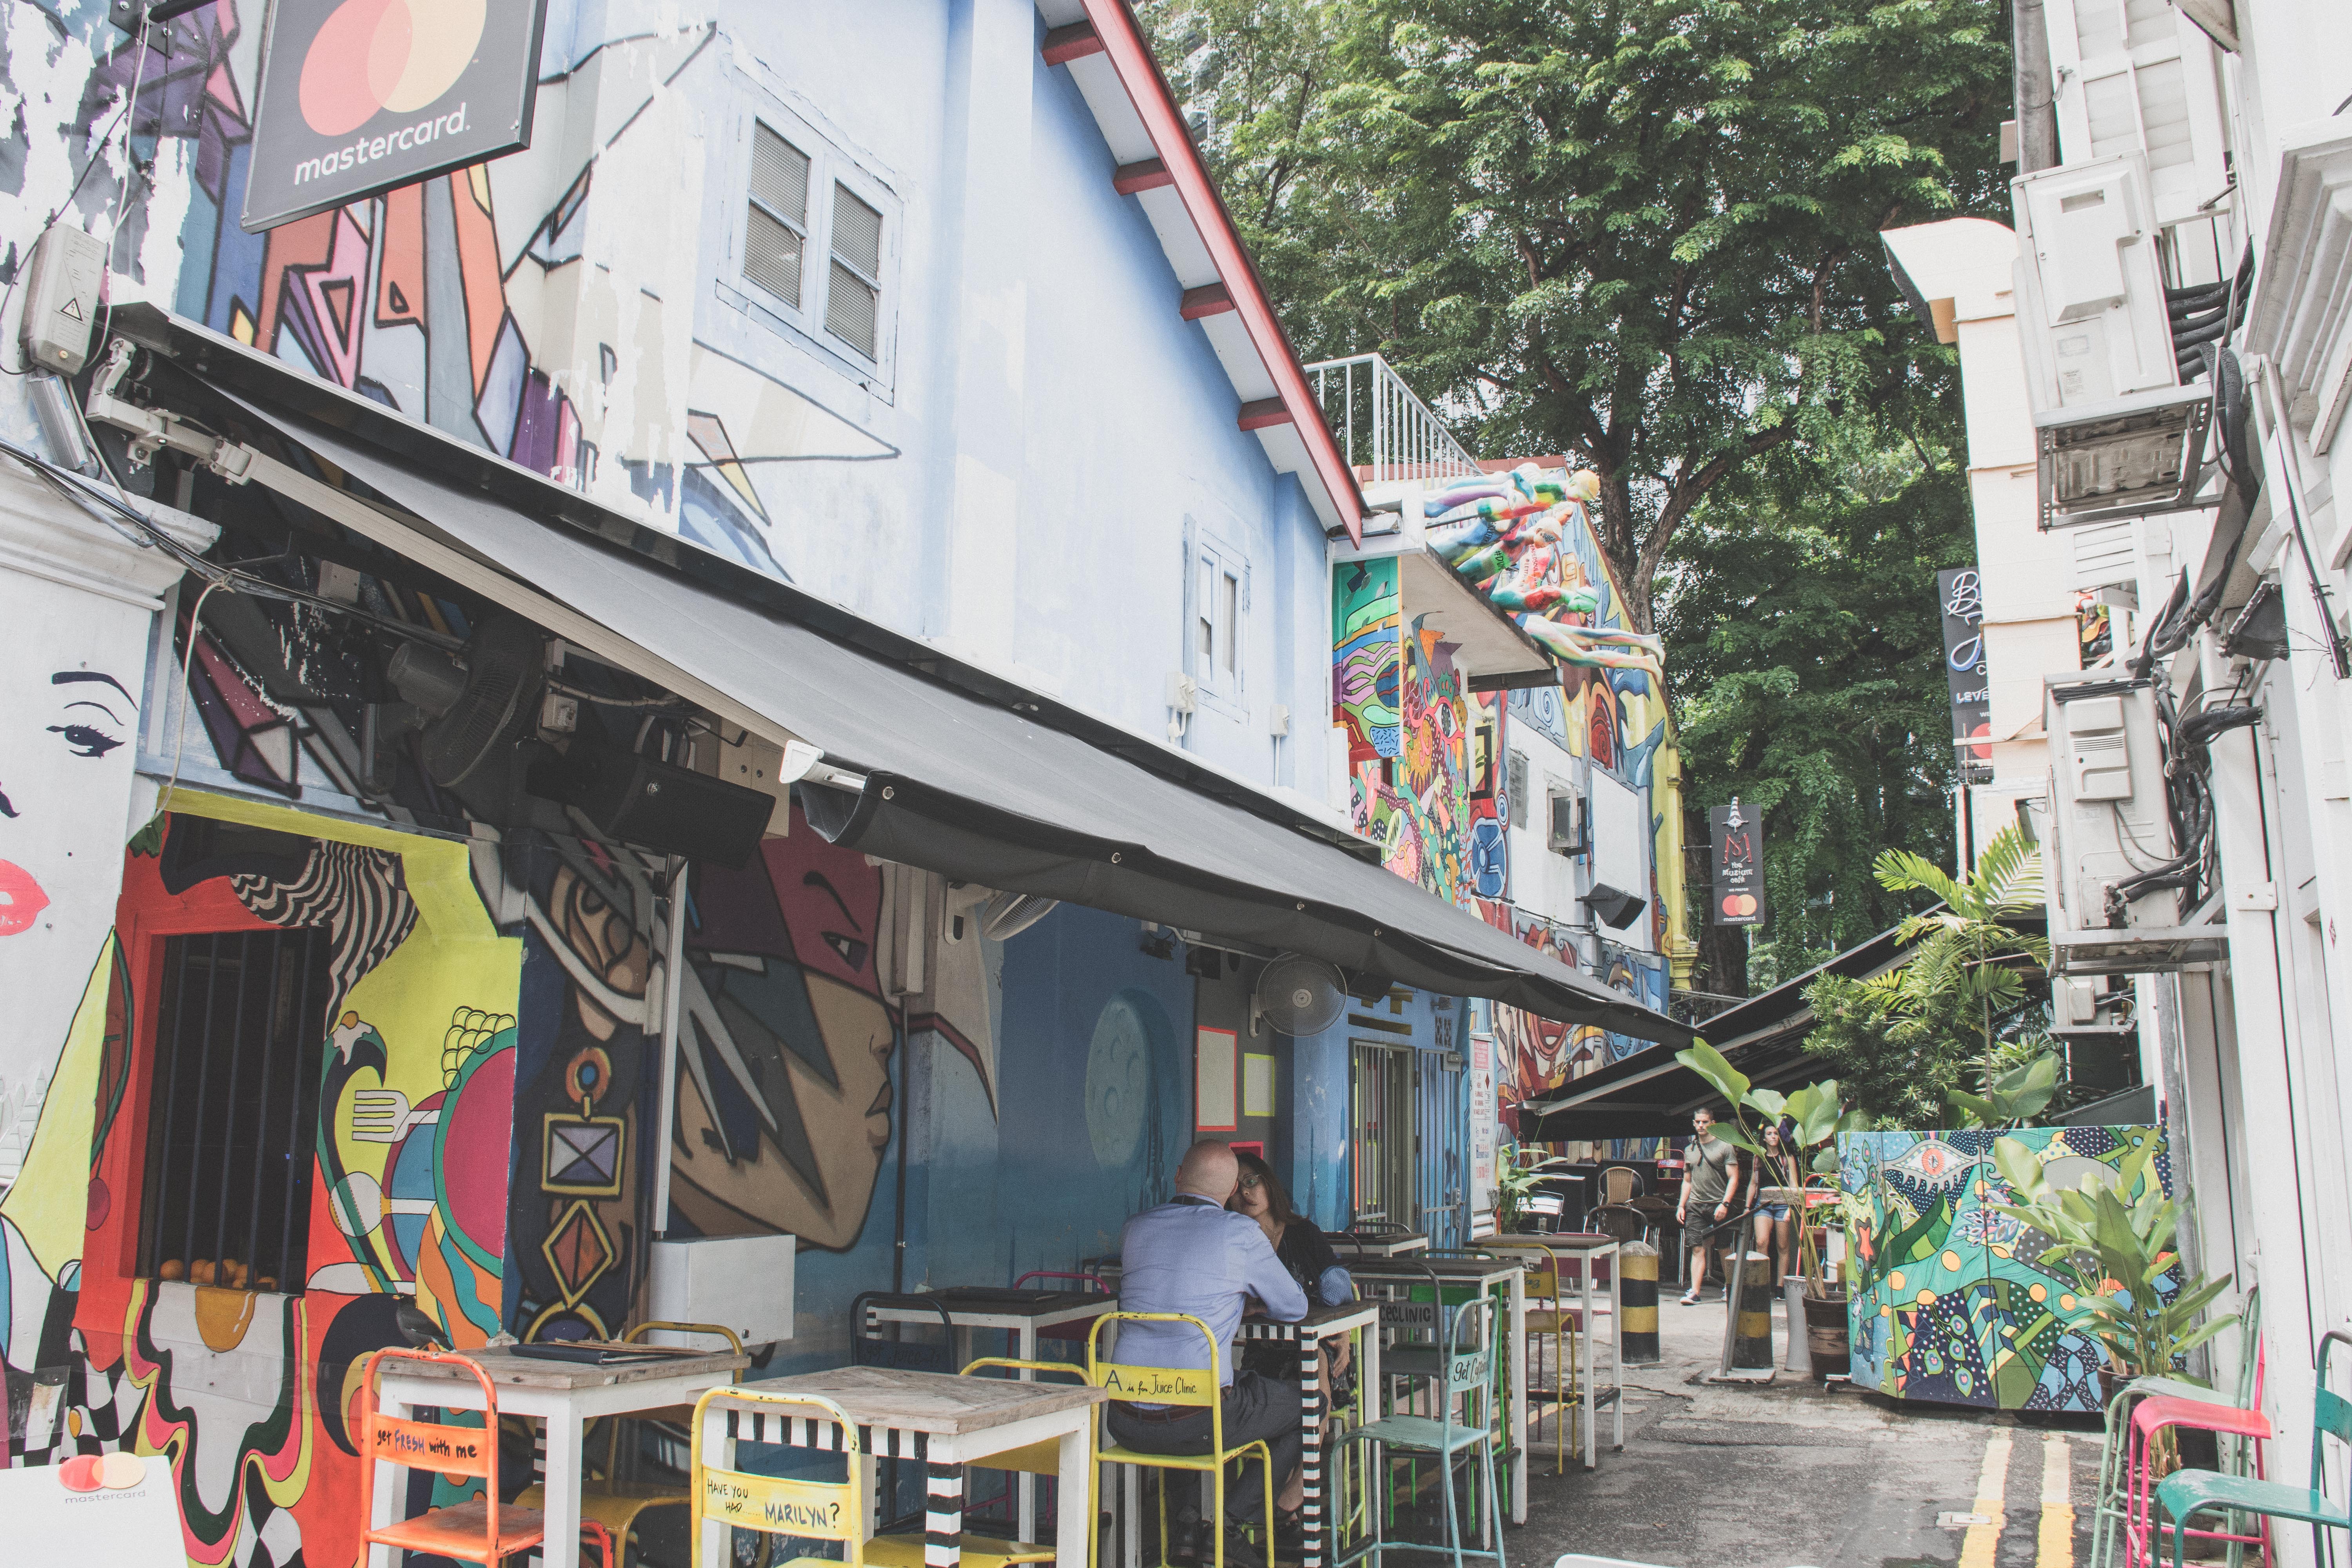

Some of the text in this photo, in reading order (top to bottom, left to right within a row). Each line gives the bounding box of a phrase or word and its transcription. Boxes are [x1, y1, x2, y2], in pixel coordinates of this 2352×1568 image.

[1454, 1360, 1470, 1382] get
[1105, 1369, 1197, 1396] A is for Juice Clinic
[377, 1429, 477, 1458] get FRESH with me
[65, 1490, 146, 1504] mastercard
[707, 1478, 748, 1499] HAVE YOU
